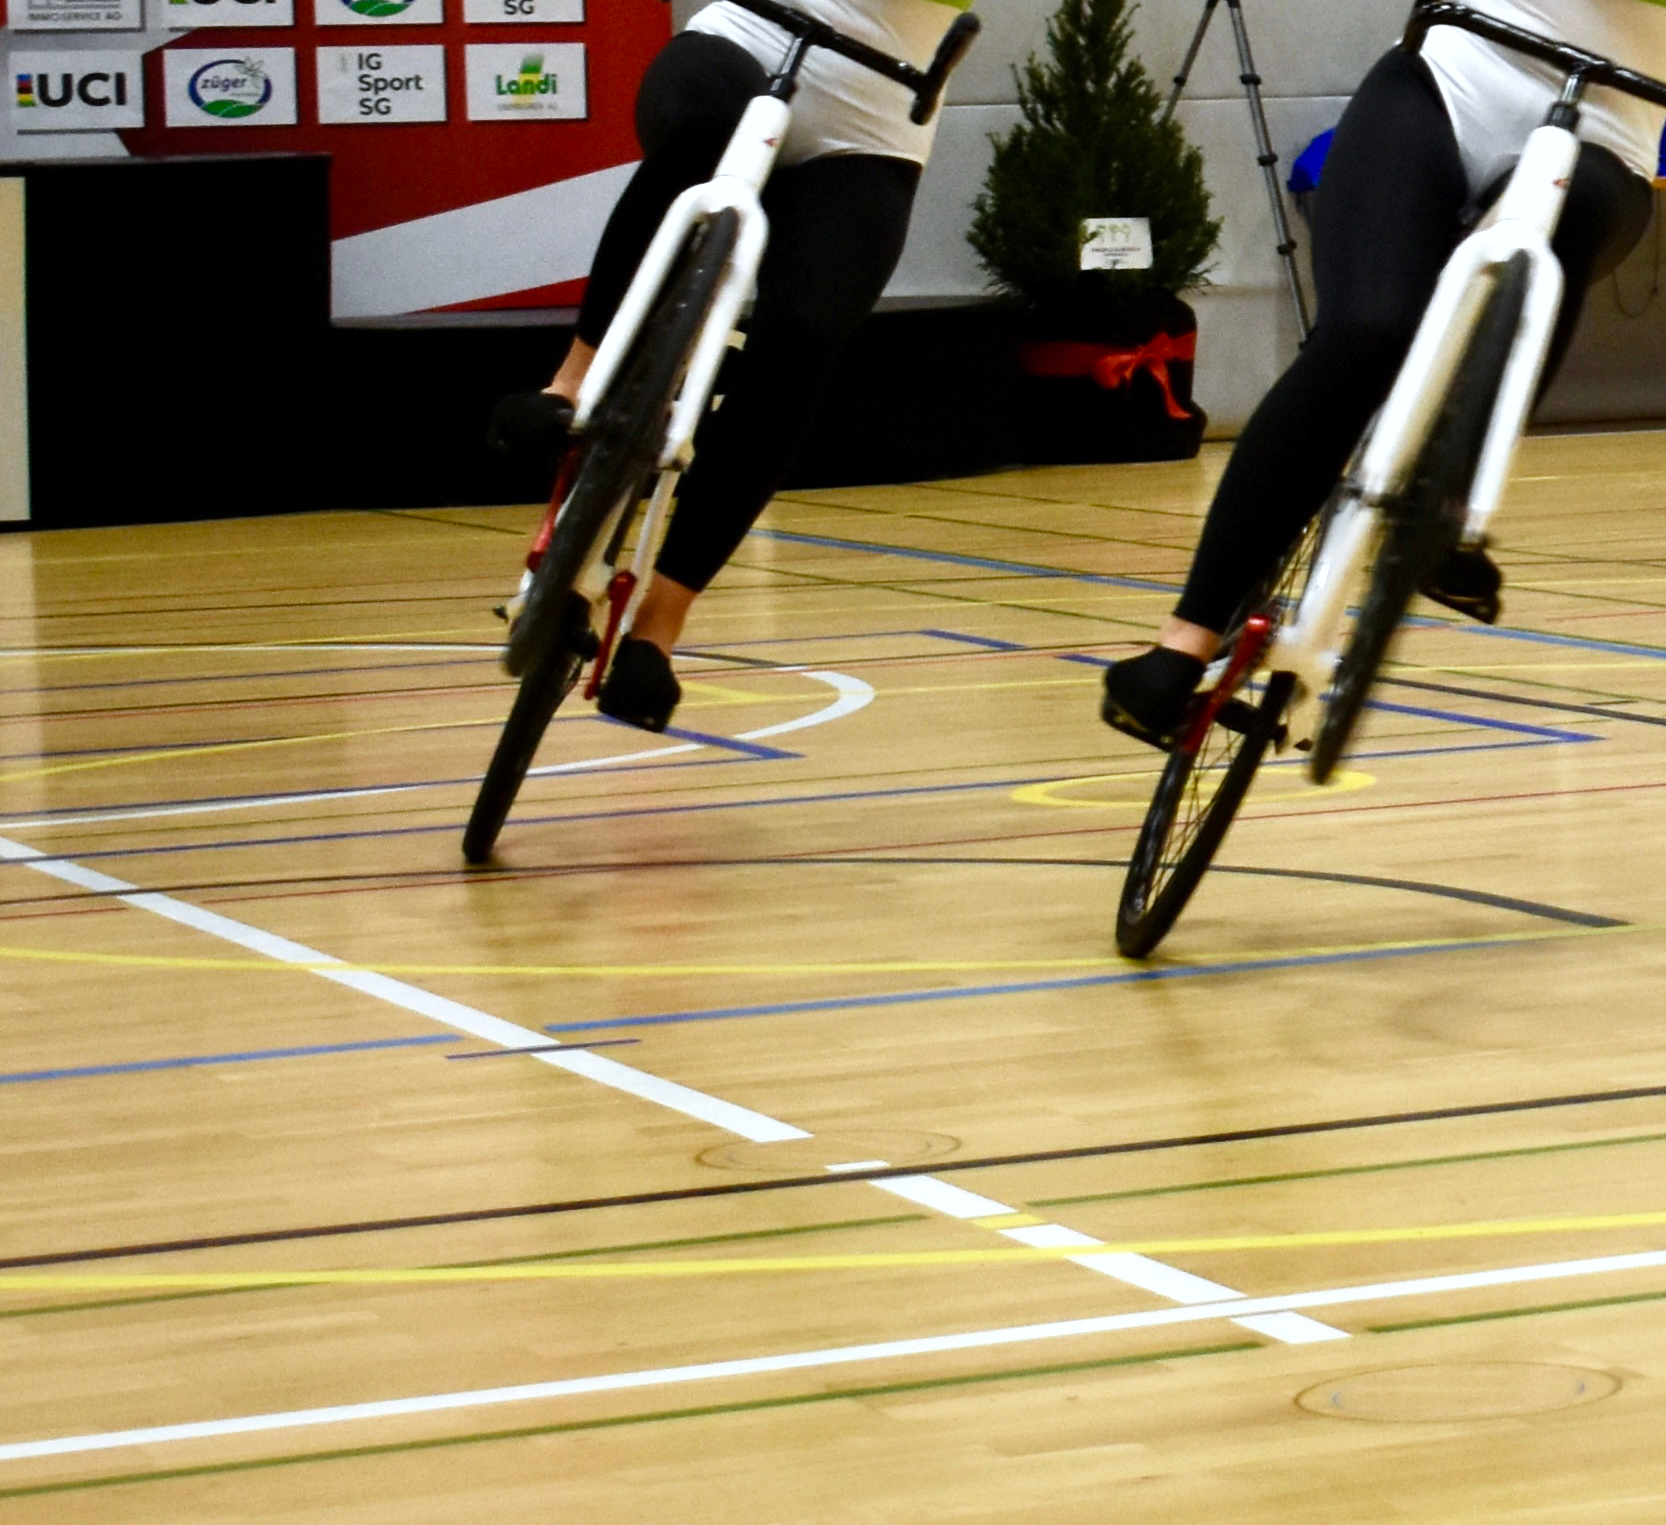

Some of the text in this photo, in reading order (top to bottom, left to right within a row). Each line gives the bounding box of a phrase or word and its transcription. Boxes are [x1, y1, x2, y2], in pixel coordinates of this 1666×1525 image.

[357, 53, 383, 70] IG
[38, 72, 127, 107] UCI
[201, 76, 248, 93] züger
[358, 74, 424, 95] Sport
[495, 74, 558, 96] Landi
[359, 98, 392, 116] SG
